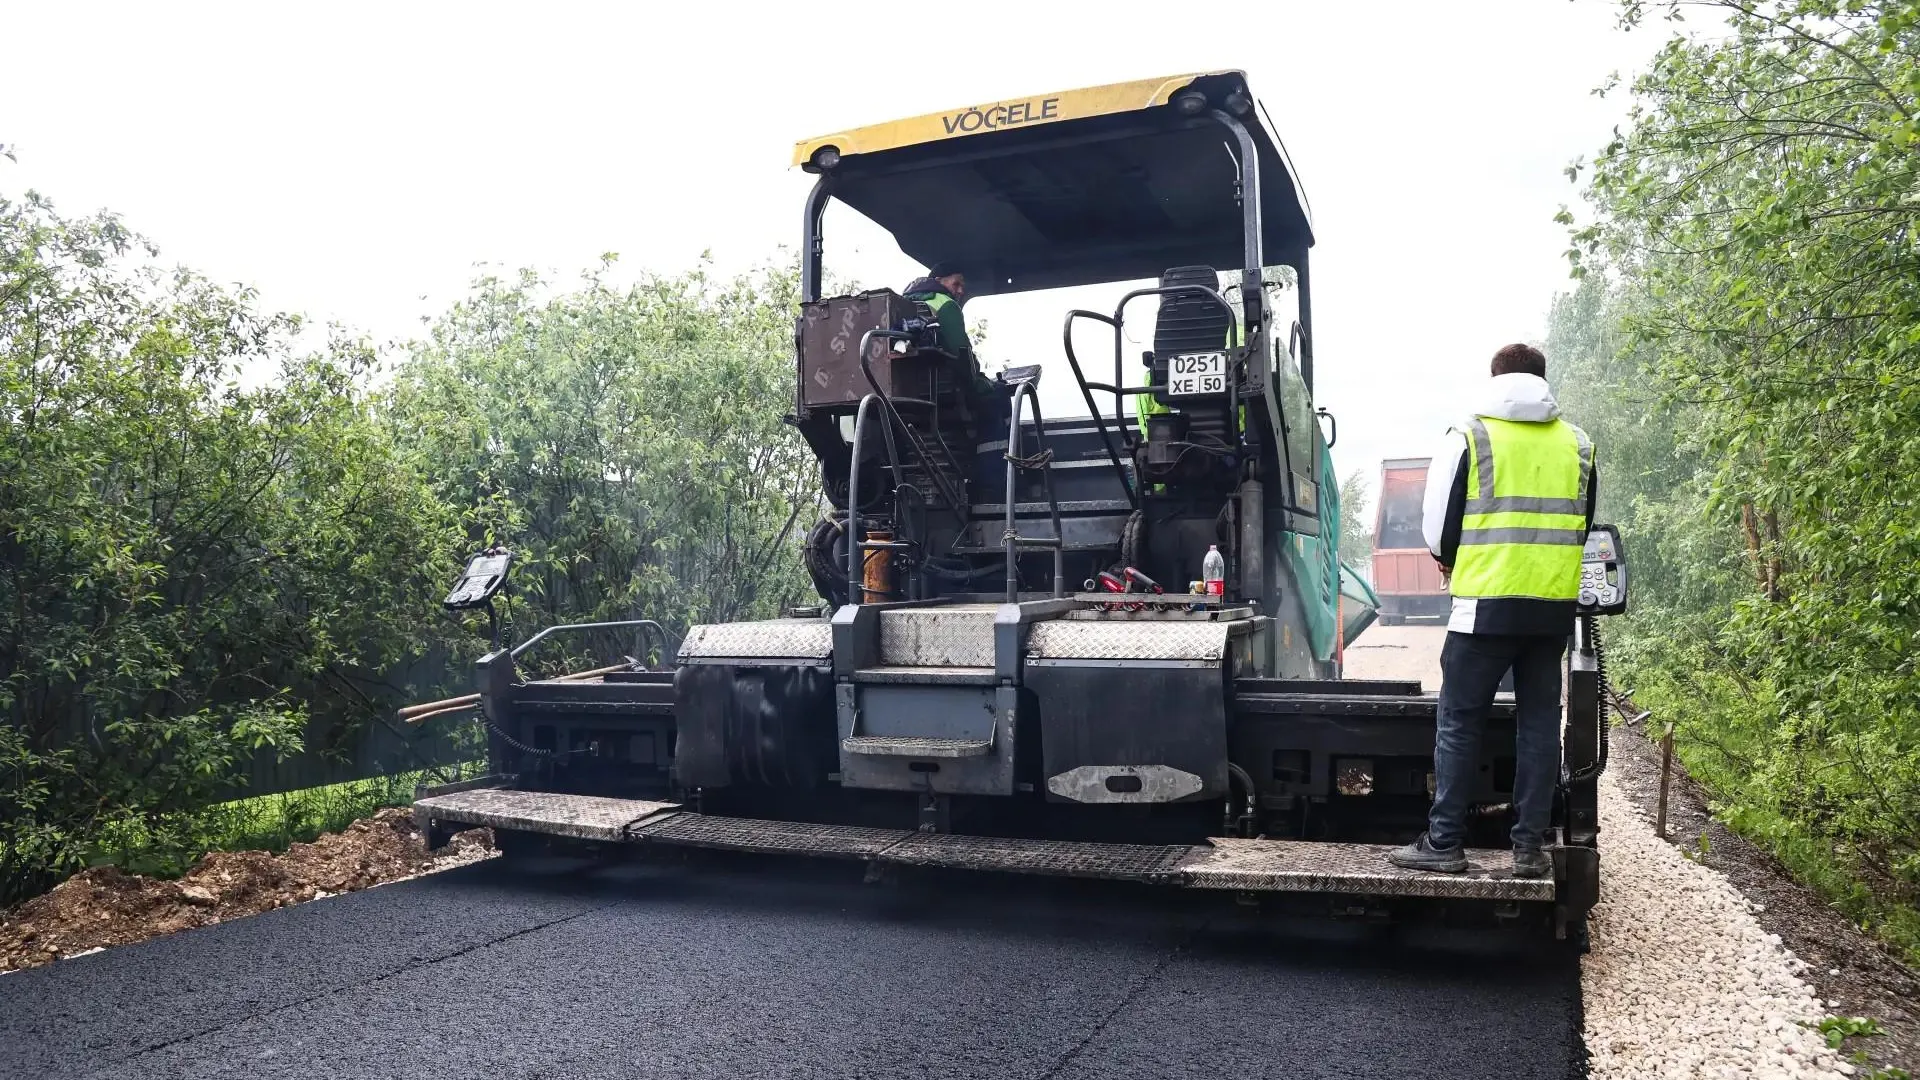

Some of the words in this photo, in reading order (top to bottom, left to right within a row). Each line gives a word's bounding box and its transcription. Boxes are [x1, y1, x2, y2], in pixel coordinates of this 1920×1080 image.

[942, 97, 1059, 134] VÖGELE
[1175, 354, 1218, 374] 0251
[1203, 377, 1221, 391] 50
